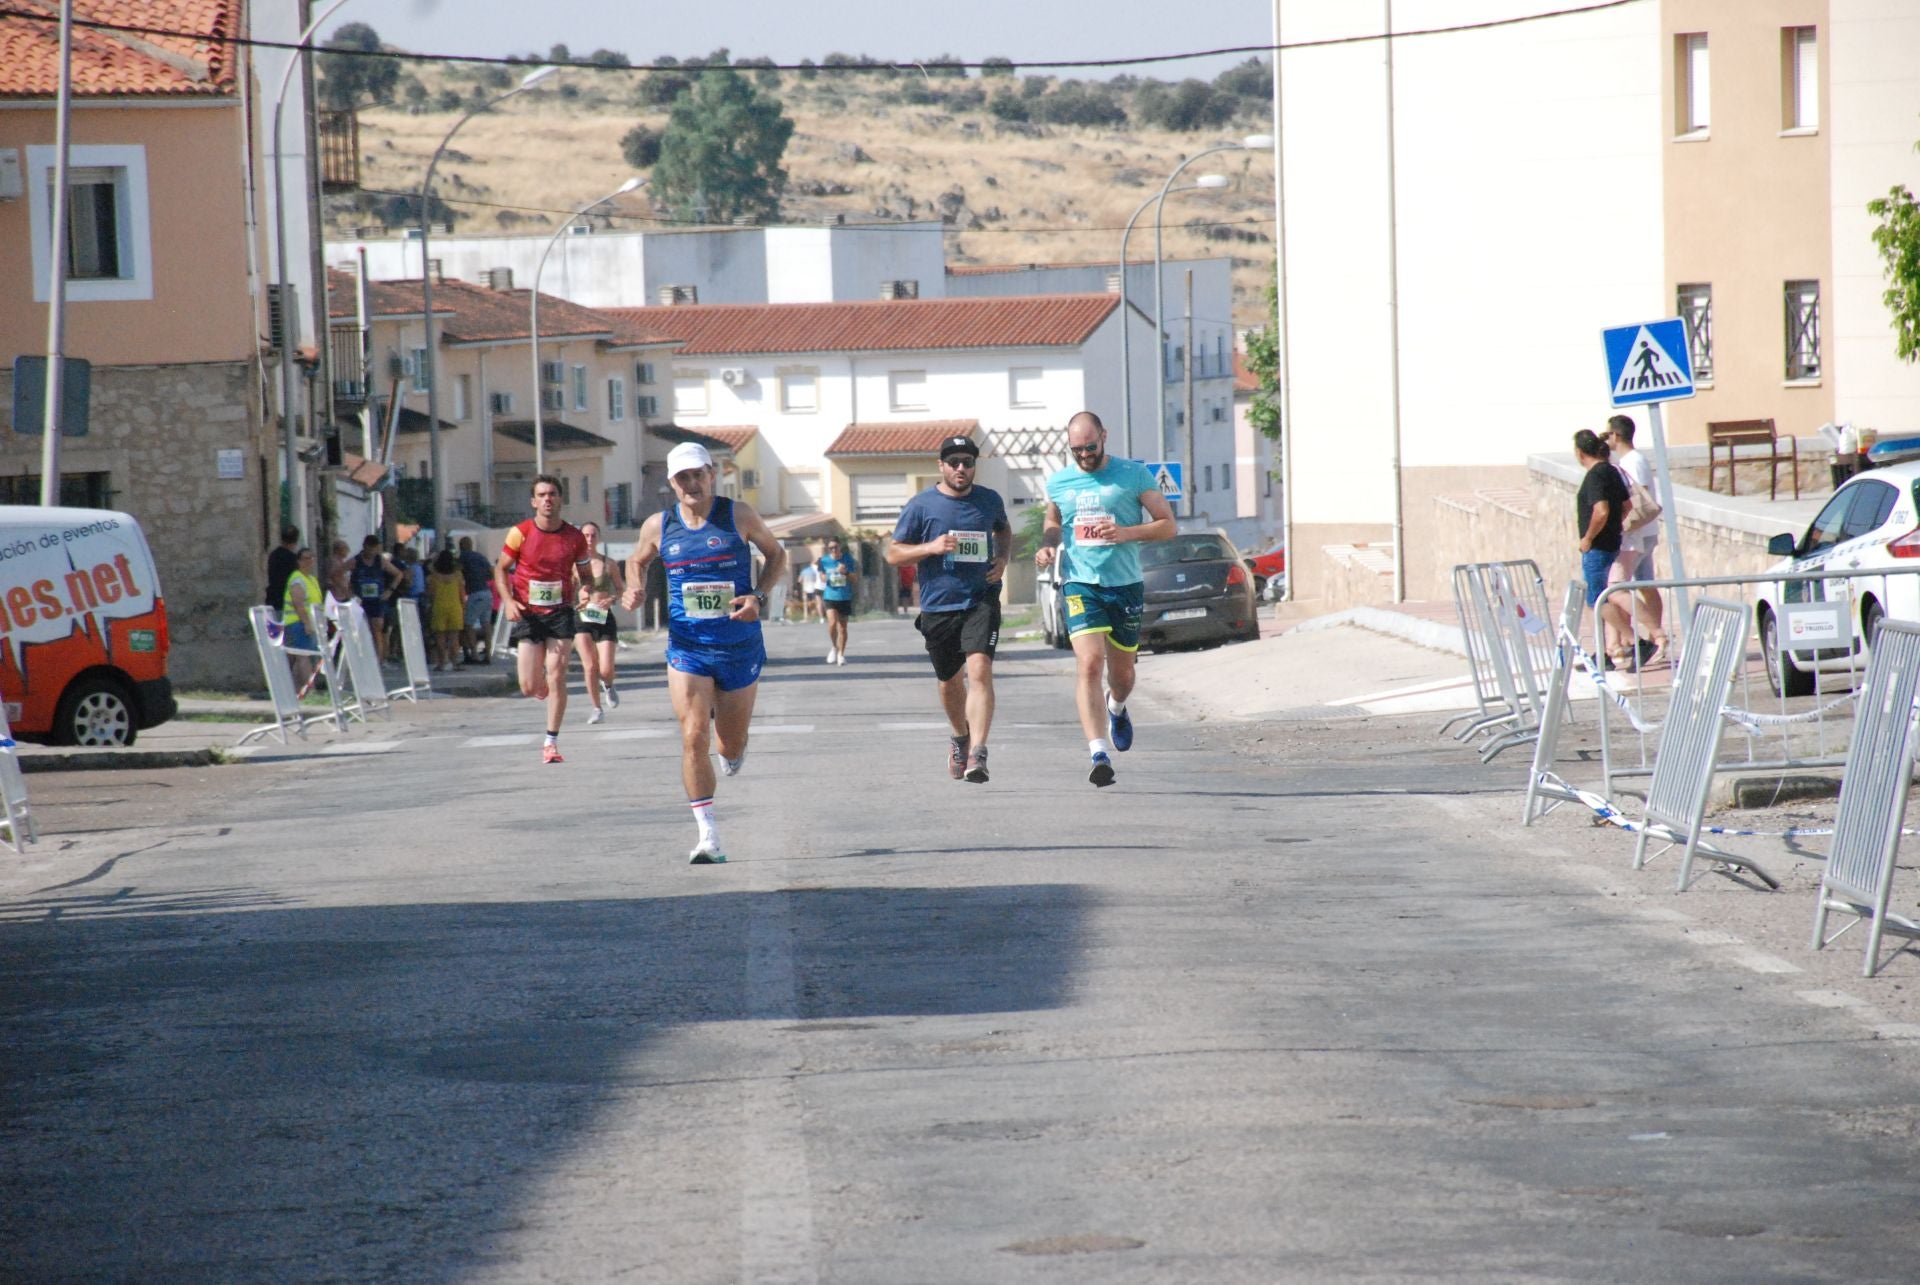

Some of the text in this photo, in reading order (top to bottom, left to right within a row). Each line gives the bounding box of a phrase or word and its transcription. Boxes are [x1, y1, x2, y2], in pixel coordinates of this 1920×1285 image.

[39, 533, 59, 549] de
[62, 518, 120, 542] eventos
[958, 542, 979, 555] 190
[540, 590, 552, 601] 23
[695, 593, 722, 610] 162
